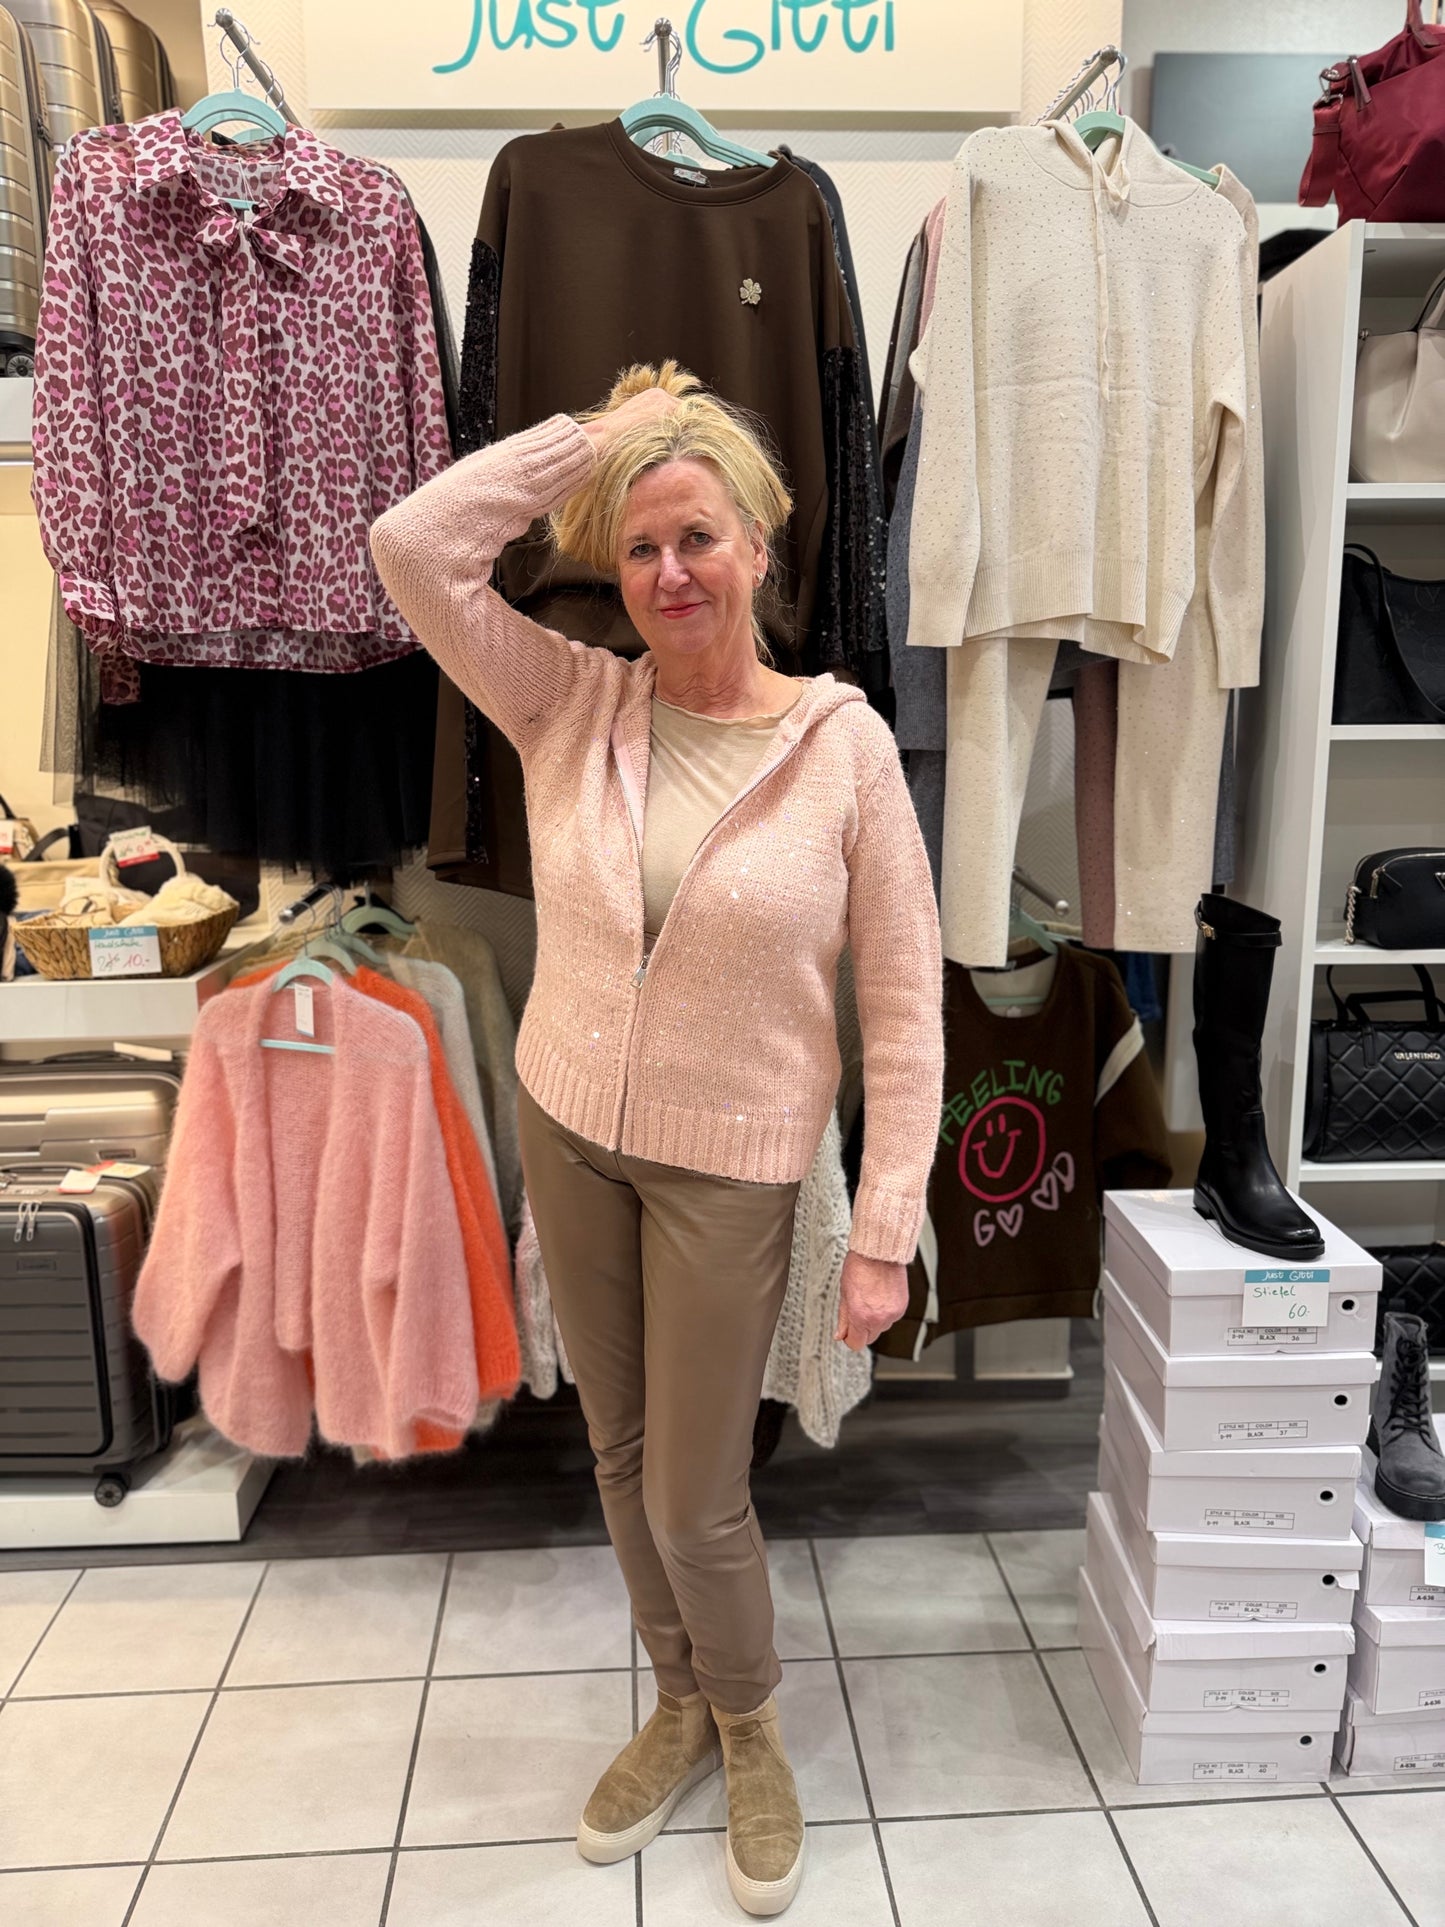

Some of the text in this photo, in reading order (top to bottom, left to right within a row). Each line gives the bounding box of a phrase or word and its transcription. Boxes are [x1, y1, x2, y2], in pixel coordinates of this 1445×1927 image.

[432, 0, 625, 74] Just
[1394, 1052, 1440, 1060] VALENTINO
[939, 1060, 1064, 1145] FEELING
[1262, 1271, 1314, 1281] Just Gitti
[1253, 1286, 1296, 1298] Stiefel
